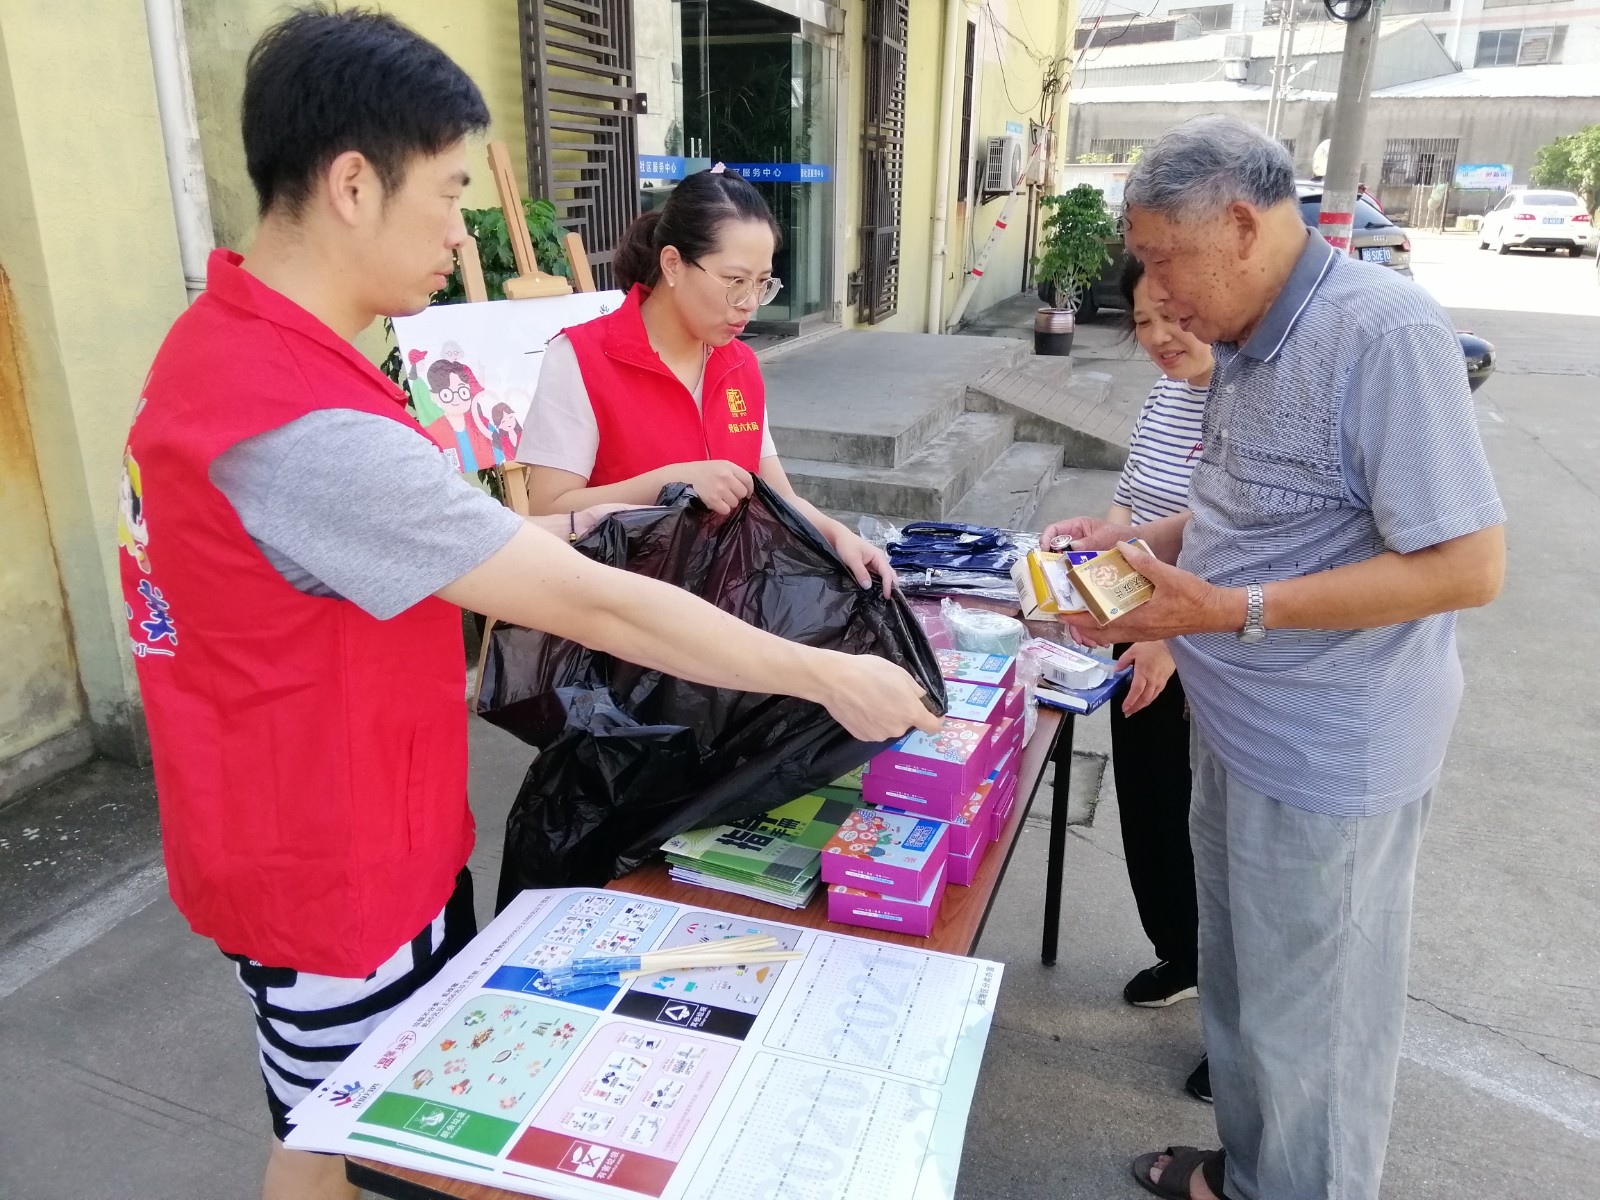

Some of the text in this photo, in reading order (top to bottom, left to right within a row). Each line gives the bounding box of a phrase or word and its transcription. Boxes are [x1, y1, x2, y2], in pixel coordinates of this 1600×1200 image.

[639, 160, 677, 174] 社区服务中心
[1114, 574, 1152, 599] 天麻片
